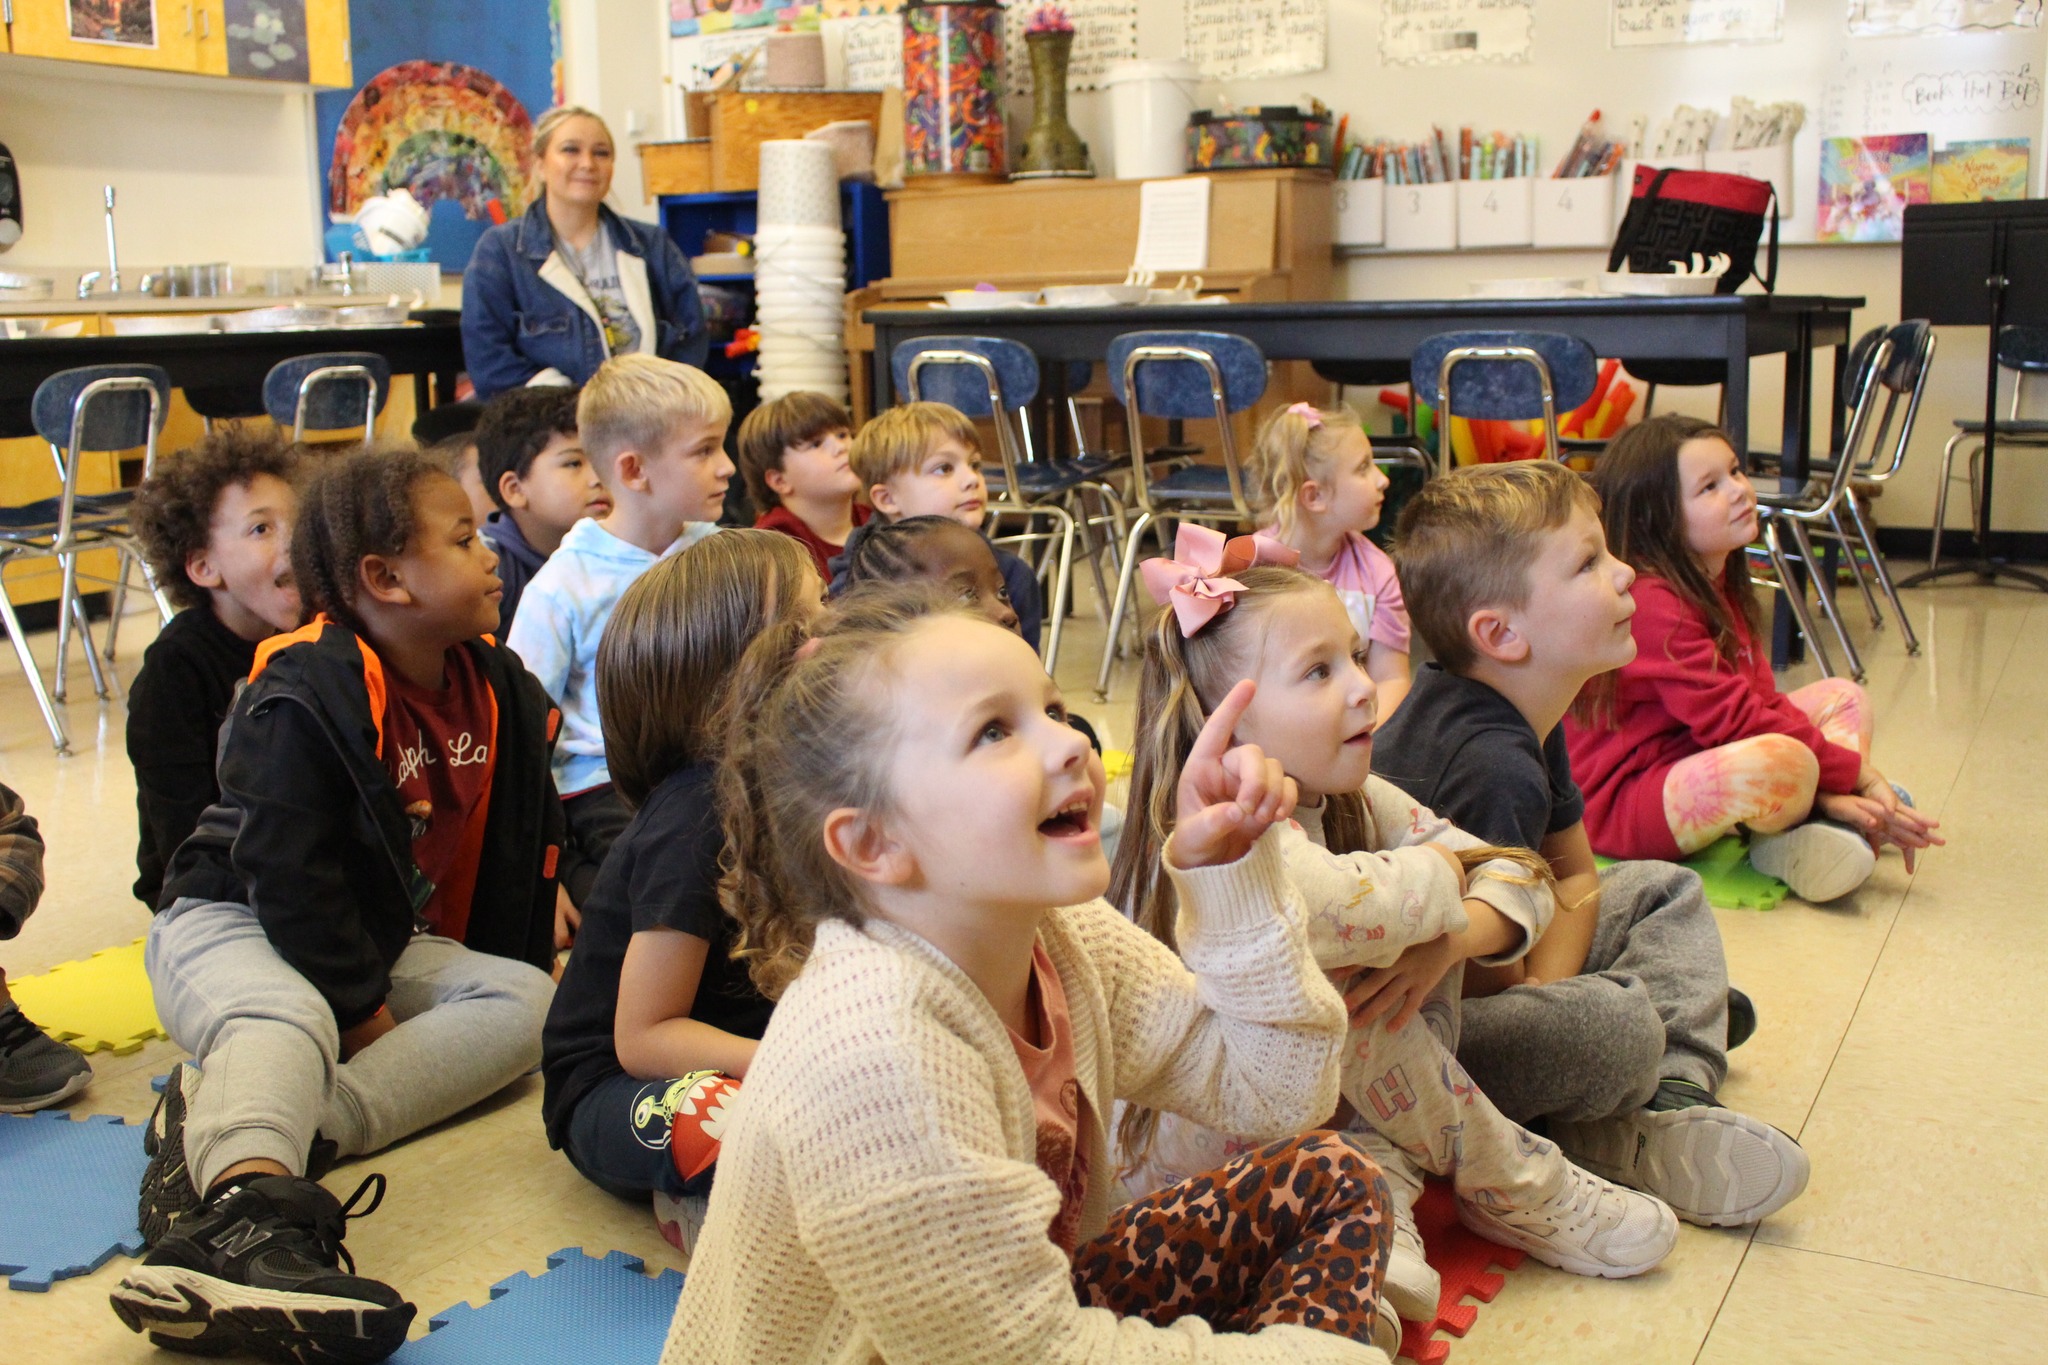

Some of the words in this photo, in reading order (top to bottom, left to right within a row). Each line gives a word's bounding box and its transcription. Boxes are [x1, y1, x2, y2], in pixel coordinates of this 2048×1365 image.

[1483, 189, 1498, 213] 4
[1557, 187, 1573, 211] 4
[448, 732, 488, 767] La
[209, 1217, 272, 1257] N
